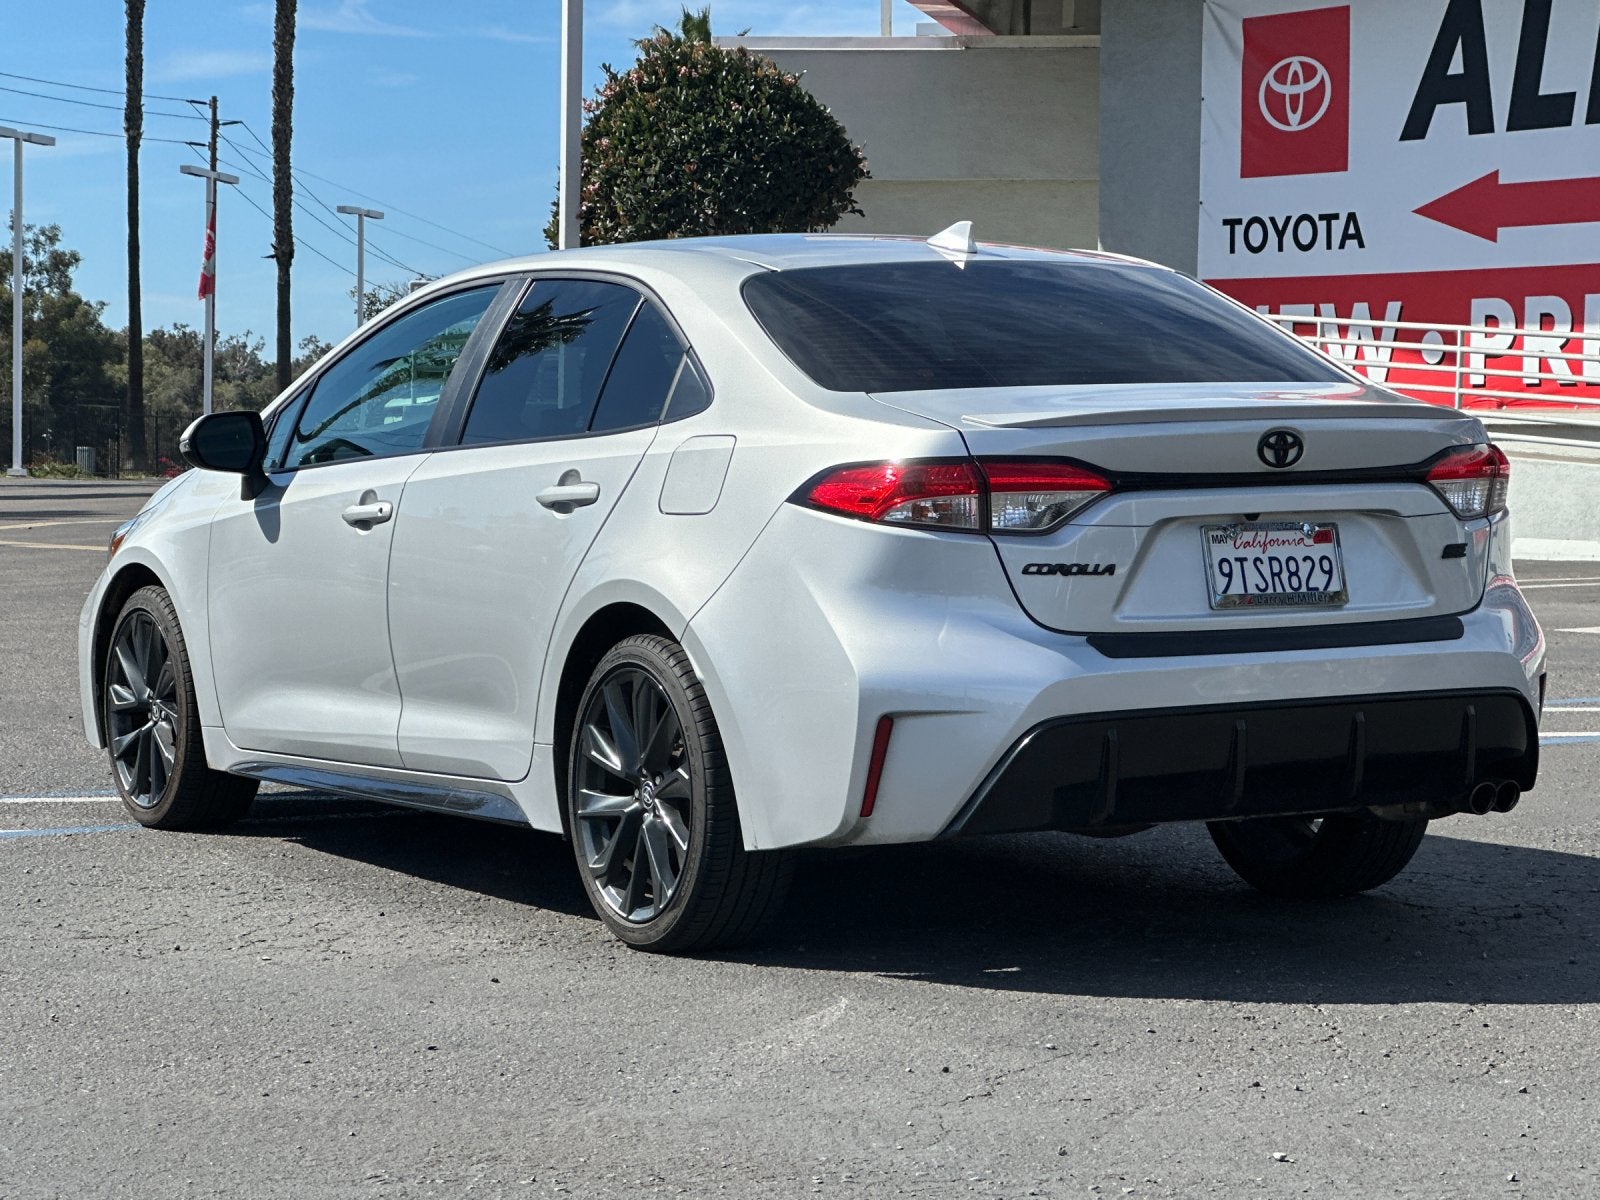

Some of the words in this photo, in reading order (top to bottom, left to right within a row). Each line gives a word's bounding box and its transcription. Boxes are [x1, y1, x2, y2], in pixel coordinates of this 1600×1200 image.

[1399, 0, 1600, 141] AL
[1222, 211, 1366, 254] TOYOTA
[1211, 534, 1229, 544] MAY
[1233, 531, 1314, 554] California
[1022, 563, 1116, 576] COROLLA
[1217, 554, 1334, 594] 9TSR829
